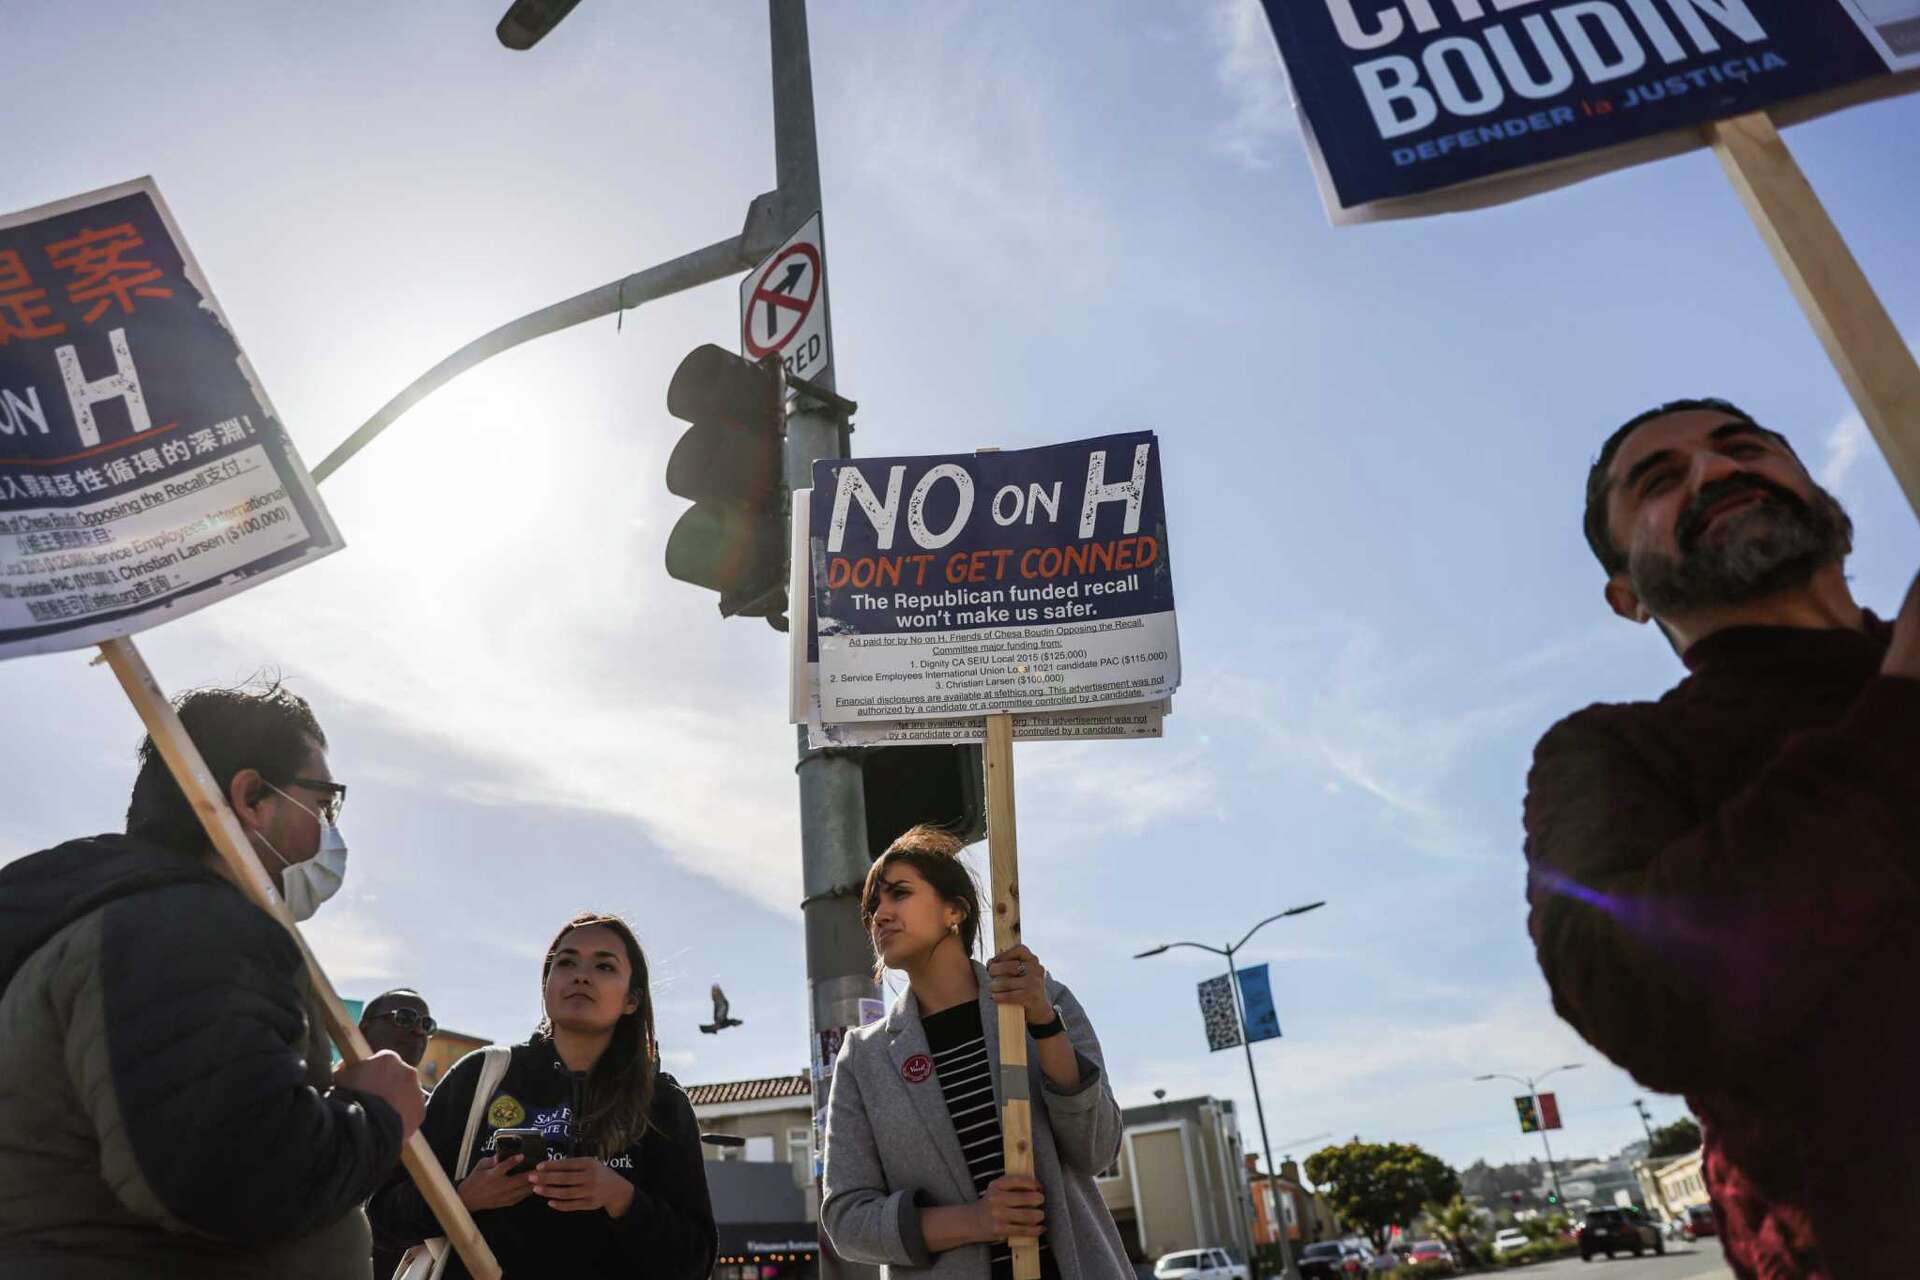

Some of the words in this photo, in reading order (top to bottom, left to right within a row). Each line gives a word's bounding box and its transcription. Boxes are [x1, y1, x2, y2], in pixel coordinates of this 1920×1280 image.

[1353, 0, 1768, 139] BOUDIN
[1392, 106, 1575, 166] DEFENDER
[1580, 99, 1613, 118] la
[784, 333, 820, 376] RED
[54, 327, 152, 448] H
[77, 498, 141, 526] Opposing
[141, 491, 165, 508] the
[827, 463, 974, 552] NO
[992, 481, 1063, 526] ON
[1078, 443, 1150, 539] H
[119, 552, 179, 580] Christian
[177, 533, 225, 560] Larsen
[226, 505, 290, 544] ($100,000)
[132, 519, 209, 555] Employees
[827, 555, 936, 590] DON'T
[945, 549, 1015, 584] GET
[1020, 536, 1158, 580] CONNED
[851, 593, 889, 611] The
[894, 588, 1003, 611] Republican
[1010, 581, 1078, 602] funded
[1085, 574, 1139, 595] recall
[896, 610, 951, 628] won't
[956, 606, 1009, 625] make
[1015, 608, 1038, 621] us
[1044, 602, 1097, 620] safer.
[849, 638, 861, 647] Ad
[864, 636, 882, 647] paid
[884, 636, 895, 646] for
[897, 636, 907, 646] by
[910, 634, 923, 644] No
[925, 636, 936, 644] on
[950, 632, 981, 643] Friends
[983, 631, 993, 640] of
[994, 630, 1022, 640] Chesa
[1025, 627, 1054, 638] Boudin
[1056, 624, 1097, 635] Opposing
[1099, 622, 1113, 631] the
[1115, 618, 1144, 629] Recall.
[932, 645, 978, 656] Committee
[980, 642, 1004, 653] major
[1007, 641, 1038, 651] funding
[1040, 639, 1063, 649] from:
[841, 673, 873, 683] Service
[875, 672, 923, 682] Employees
[925, 668, 978, 679] International
[980, 666, 1006, 675] Union
[1033, 664, 1054, 673] 1021
[1056, 660, 1098, 671] candidate
[1100, 657, 1120, 667] PAC
[1121, 653, 1168, 666] ($115,000)
[920, 659, 949, 670] Dignity
[952, 658, 965, 667] CA
[967, 657, 989, 666] SEIU
[991, 655, 1014, 665] Local
[1017, 653, 1039, 662] 2015
[1041, 650, 1088, 661] ($125,000)
[836, 695, 875, 706] Financial
[877, 693, 925, 704] disclosures
[927, 695, 941, 703] are
[943, 691, 982, 702] available
[984, 691, 993, 699] at
[1049, 685, 1066, 695] This
[1068, 680, 1129, 693] advertisement
[1131, 678, 1149, 687] was
[1151, 674, 1165, 684] not
[945, 680, 984, 690] Christian
[985, 678, 1016, 687] Larsen
[1017, 674, 1064, 685] ($100,000)
[857, 705, 902, 716] authorized
[904, 704, 914, 715] by
[925, 702, 968, 713] candidate
[969, 703, 979, 711] or
[988, 698, 1033, 709] committee
[1035, 695, 1077, 706] controlled
[1079, 693, 1090, 704] by
[1100, 689, 1145, 700] candidate.
[909, 730, 950, 741] candidate
[952, 730, 962, 739] or
[1018, 726, 1060, 737] controlled
[1062, 726, 1072, 737] by
[1052, 715, 1112, 726] advertisement
[1114, 716, 1131, 725] was
[1133, 715, 1148, 724] not
